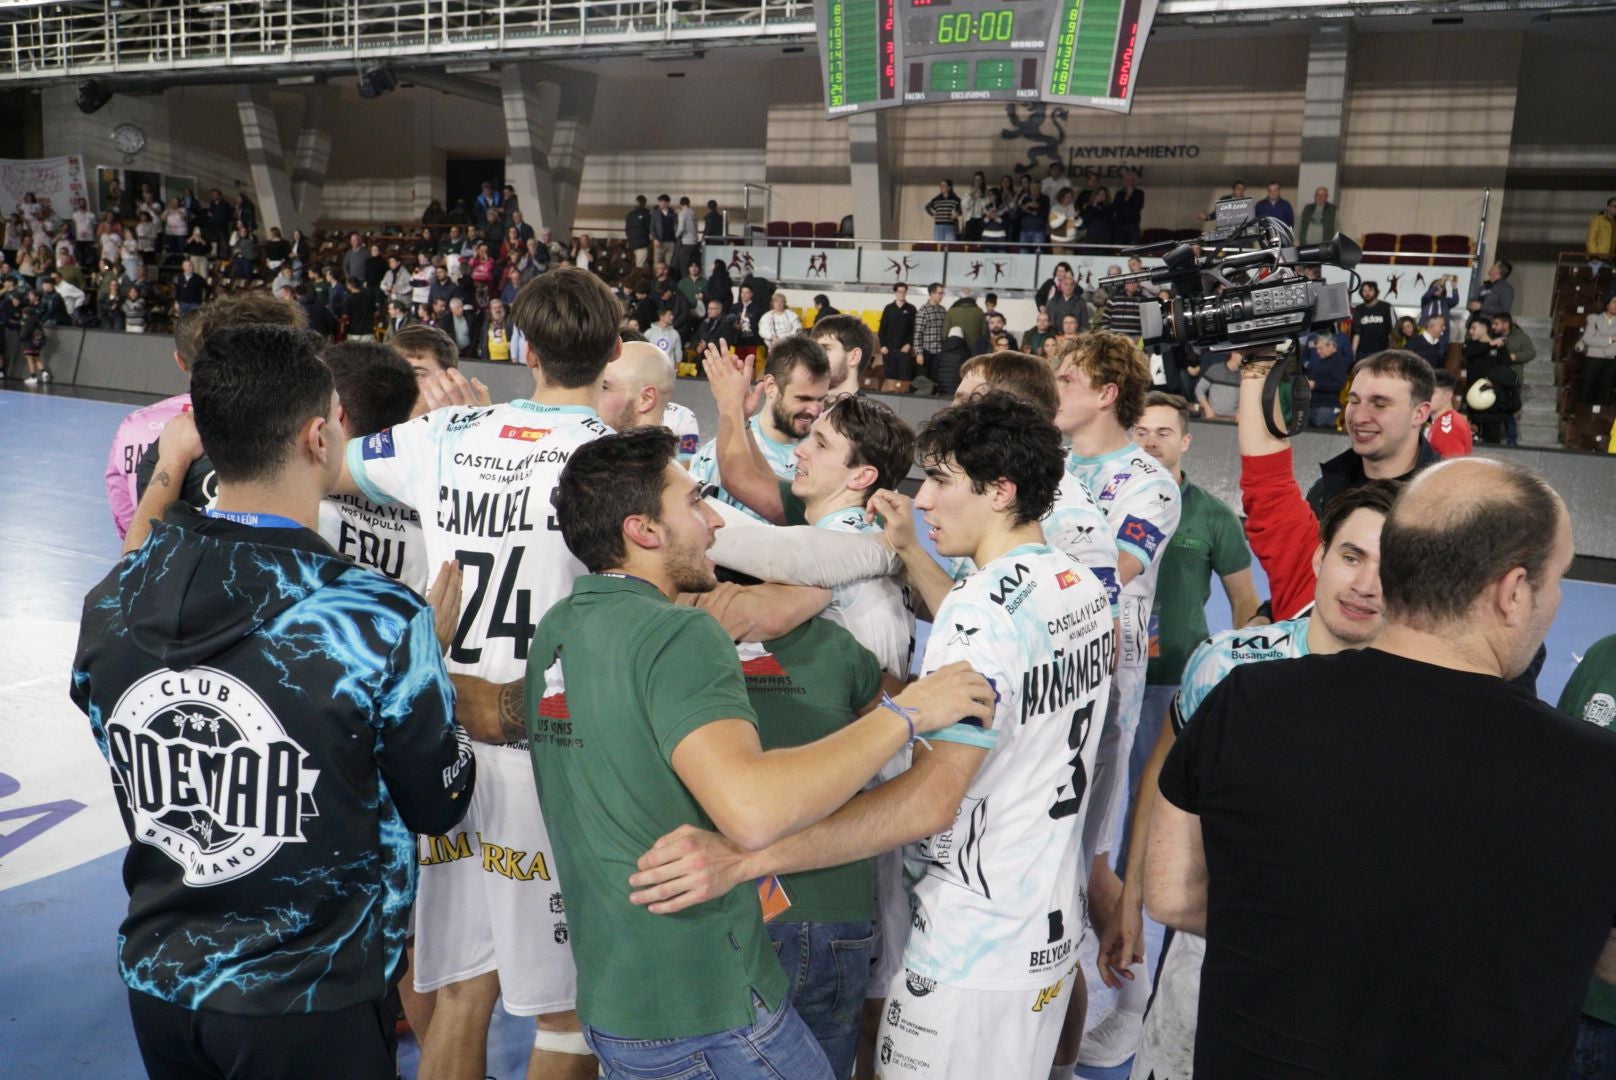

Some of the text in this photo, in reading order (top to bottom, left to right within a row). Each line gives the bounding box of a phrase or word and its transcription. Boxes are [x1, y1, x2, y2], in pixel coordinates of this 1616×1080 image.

[884, 18, 894, 30] 2
[938, 11, 1013, 43] 60:00
[830, 39, 842, 49] 13
[1010, 41, 1045, 49] MONDO
[1060, 33, 1074, 45] 10
[1058, 46, 1133, 60] 13 2
[885, 64, 894, 76] 6
[1056, 59, 1131, 73] 15 2
[1054, 71, 1068, 82] 18
[1051, 83, 1066, 95] 19
[1074, 144, 1200, 159] AYUNTAMIENTO
[1360, 314, 1384, 325] adidas
[454, 452, 526, 471] CASTILLA
[534, 447, 570, 463] LEÓN
[479, 473, 497, 481] NOS
[341, 505, 407, 532] NOS IMPULSA
[388, 505, 398, 520] Y
[450, 546, 537, 664] 24
[1004, 580, 1037, 615] Busanauto
[1047, 607, 1086, 635] CASTILLA
[161, 678, 230, 702] CLUB
[1048, 699, 1096, 820] 3
[109, 723, 303, 838] ADEMAR
[145, 829, 256, 876] BALOMANO
[1030, 938, 1072, 967] BELYCAR
[901, 1018, 939, 1036] AYUNTAMIENTO
[893, 1051, 930, 1069] DIPUTACIÓN
